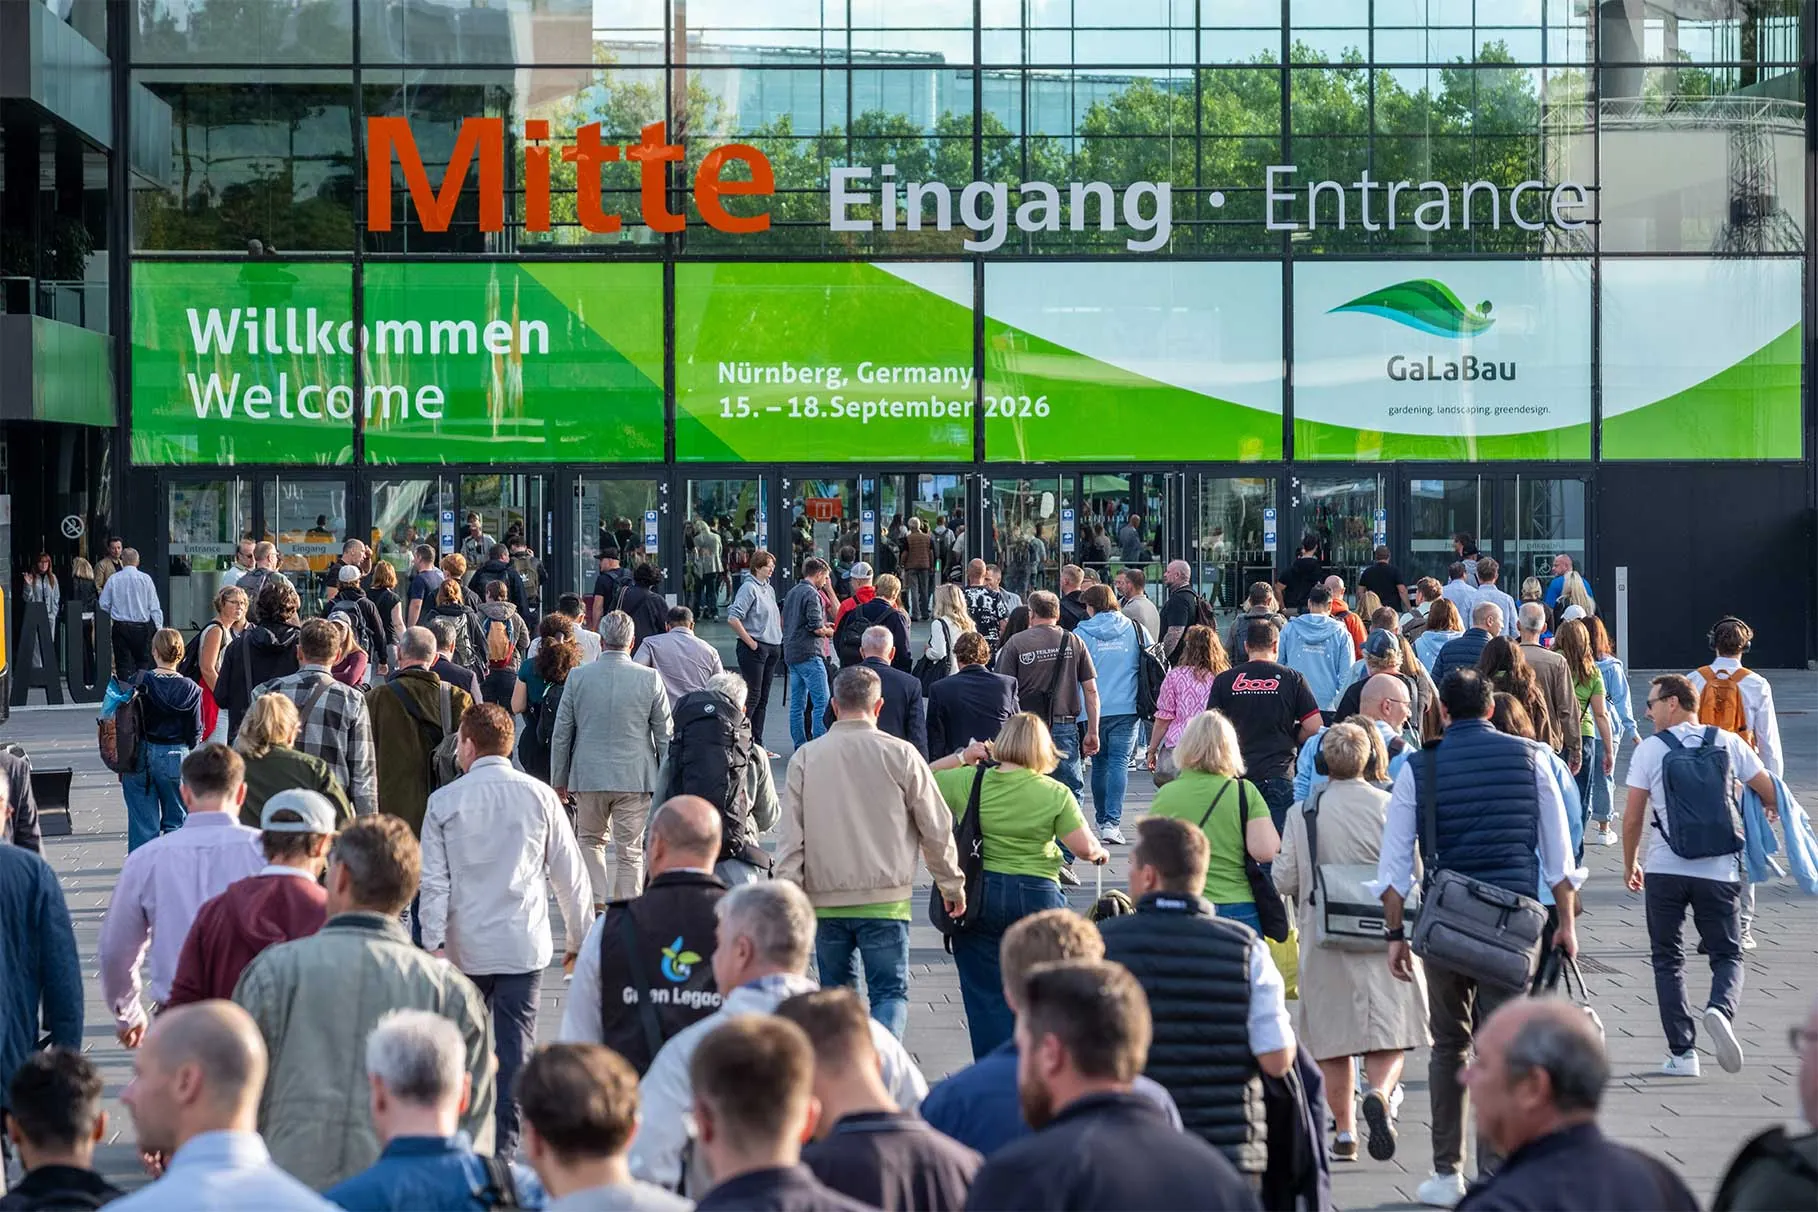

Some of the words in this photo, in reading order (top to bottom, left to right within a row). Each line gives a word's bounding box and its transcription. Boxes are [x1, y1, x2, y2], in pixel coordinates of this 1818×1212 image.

[368, 116, 775, 233] Mitte
[829, 164, 1172, 252] Eingang
[1266, 165, 1589, 232] Entrance
[186, 307, 550, 355] Willkommen
[718, 361, 849, 390] Nürnberg,
[856, 362, 975, 390] Germany
[1387, 355, 1516, 381] GaLaBau
[186, 372, 445, 419] Welcome
[719, 396, 759, 418] 15.
[984, 396, 1051, 418] 2026
[1494, 404, 1551, 416] greendesign.
[184, 544, 221, 553] Entrance
[292, 544, 327, 553] Eingang
[673, 986, 725, 1010] Legac
